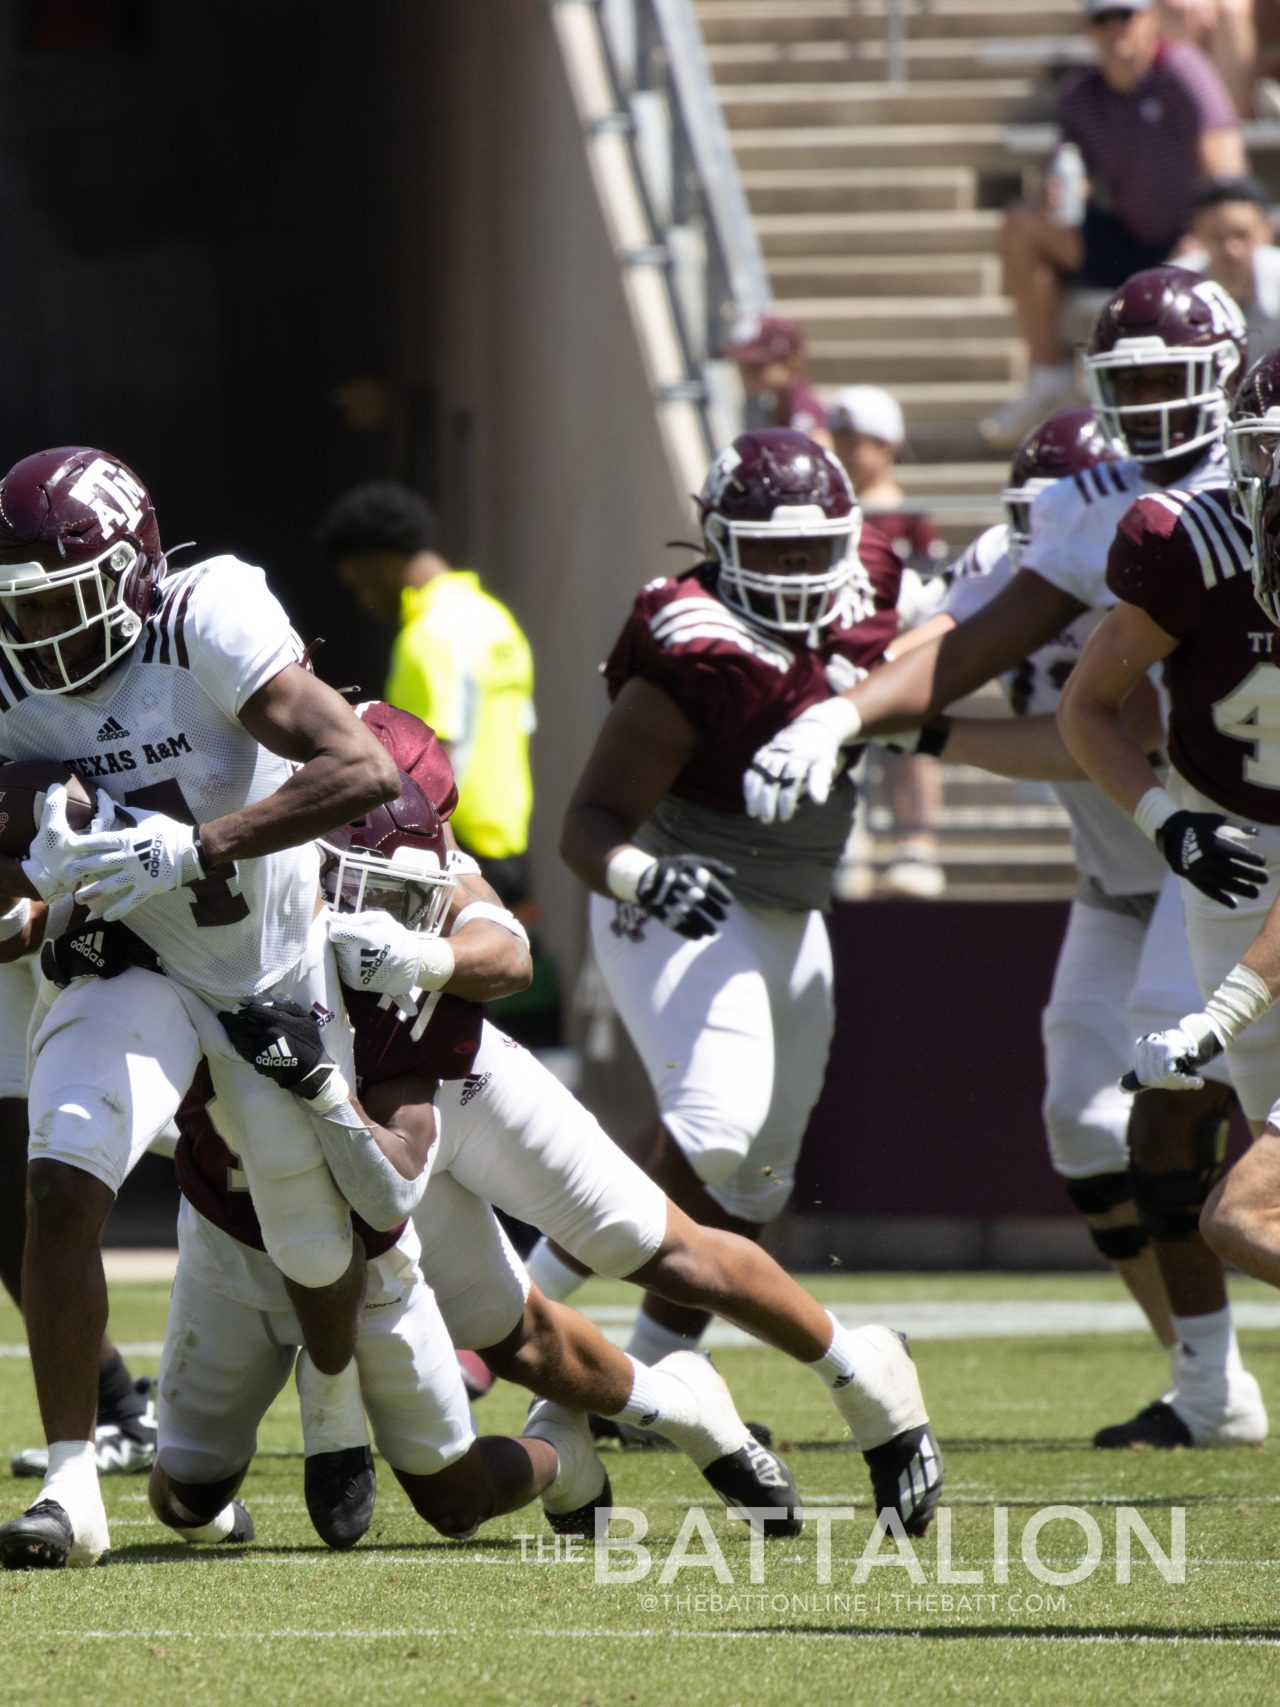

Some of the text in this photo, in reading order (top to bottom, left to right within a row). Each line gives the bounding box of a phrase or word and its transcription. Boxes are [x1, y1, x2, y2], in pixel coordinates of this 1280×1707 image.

[96, 729, 130, 743] adidas
[62, 732, 193, 778] TEXAS A&M
[150, 832, 164, 878] adidas
[70, 939, 106, 968] adidas
[362, 943, 392, 985] adidas
[255, 1055, 299, 1068] adidas
[460, 1071, 492, 1107] adidas
